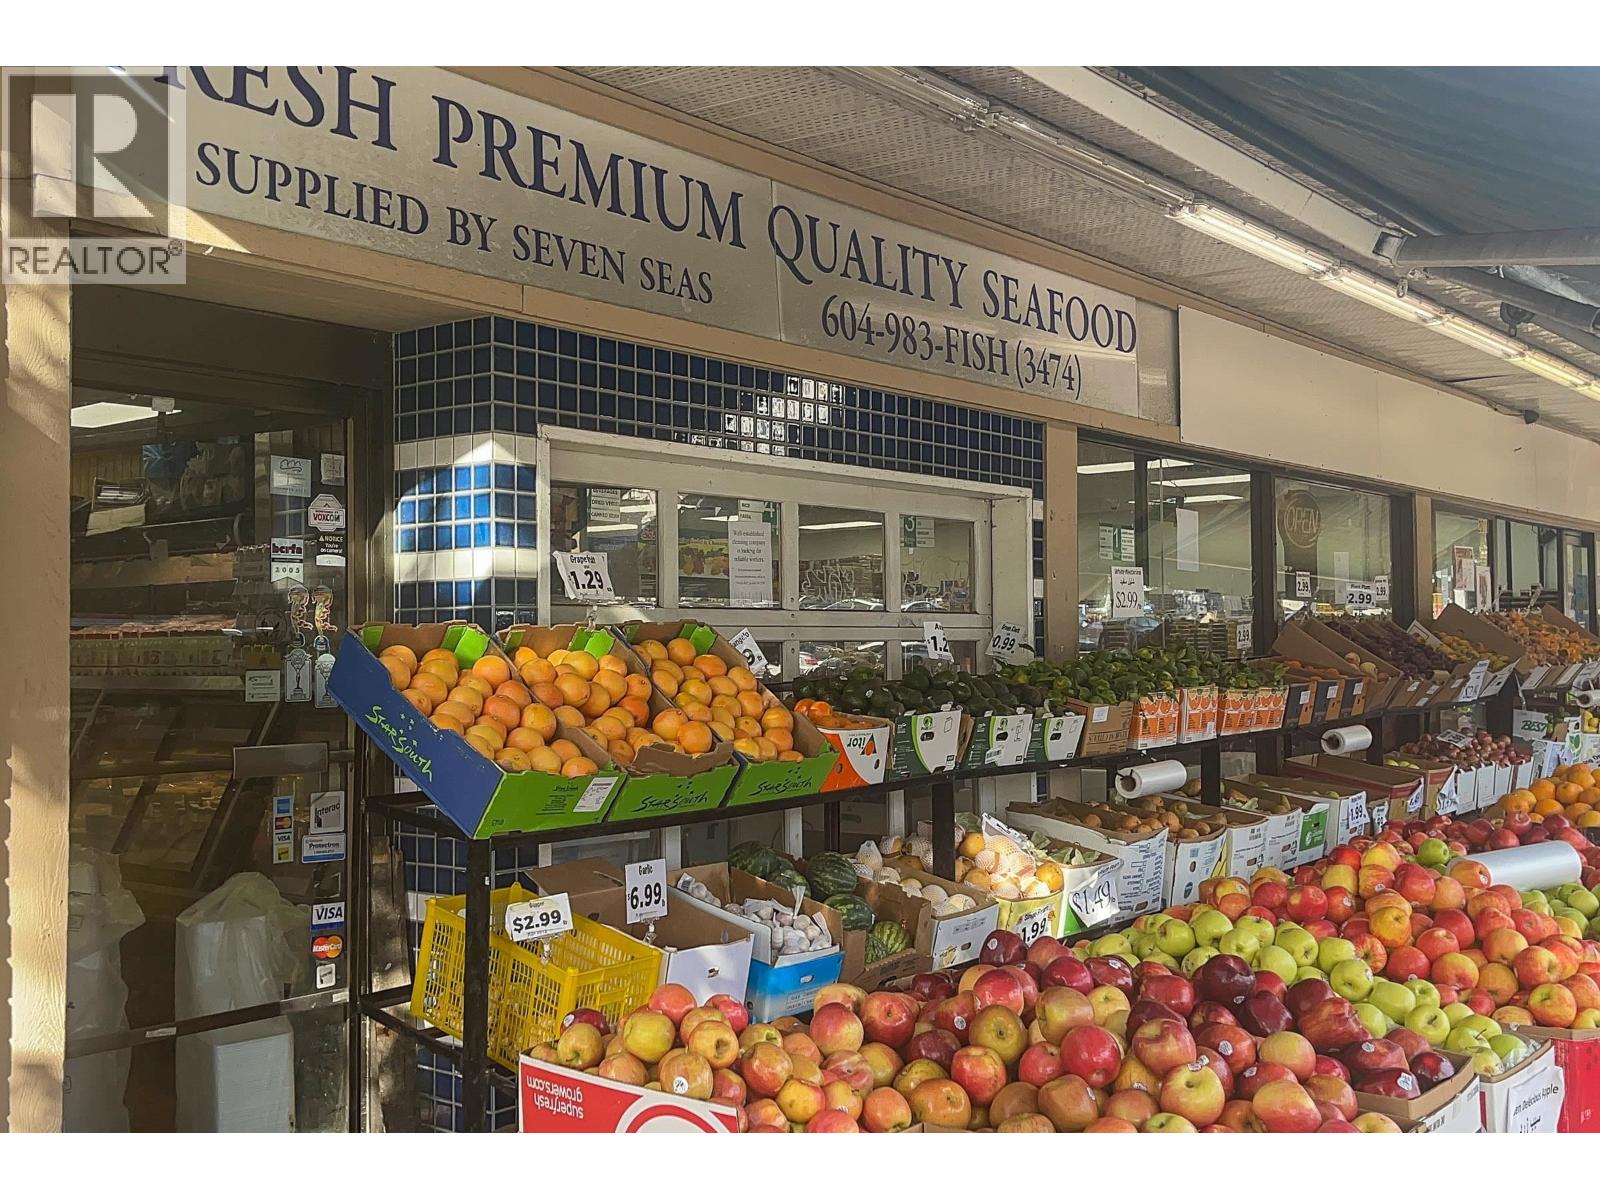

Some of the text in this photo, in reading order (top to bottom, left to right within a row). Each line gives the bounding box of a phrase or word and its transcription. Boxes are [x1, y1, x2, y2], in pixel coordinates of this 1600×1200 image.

[196, 142, 713, 304] SUPPLIED BY SEVEN SEAS
[432, 95, 746, 250] PREMIUM
[768, 205, 968, 309] QUALITY
[982, 269, 1137, 354] SEAFOOD
[1287, 506, 1319, 534] OPEN
[1115, 591, 1138, 609] $2.99
[1520, 719, 1547, 733] BEST
[314, 802, 341, 818] Interac
[638, 864, 653, 876] Garlic
[314, 906, 343, 920] VISA
[512, 909, 561, 934] $2.99
[312, 943, 342, 952] MasterCard
[526, 1075, 583, 1103] growers.com
[1542, 1083, 1559, 1099] Apple
[533, 1093, 585, 1120] superfresh
